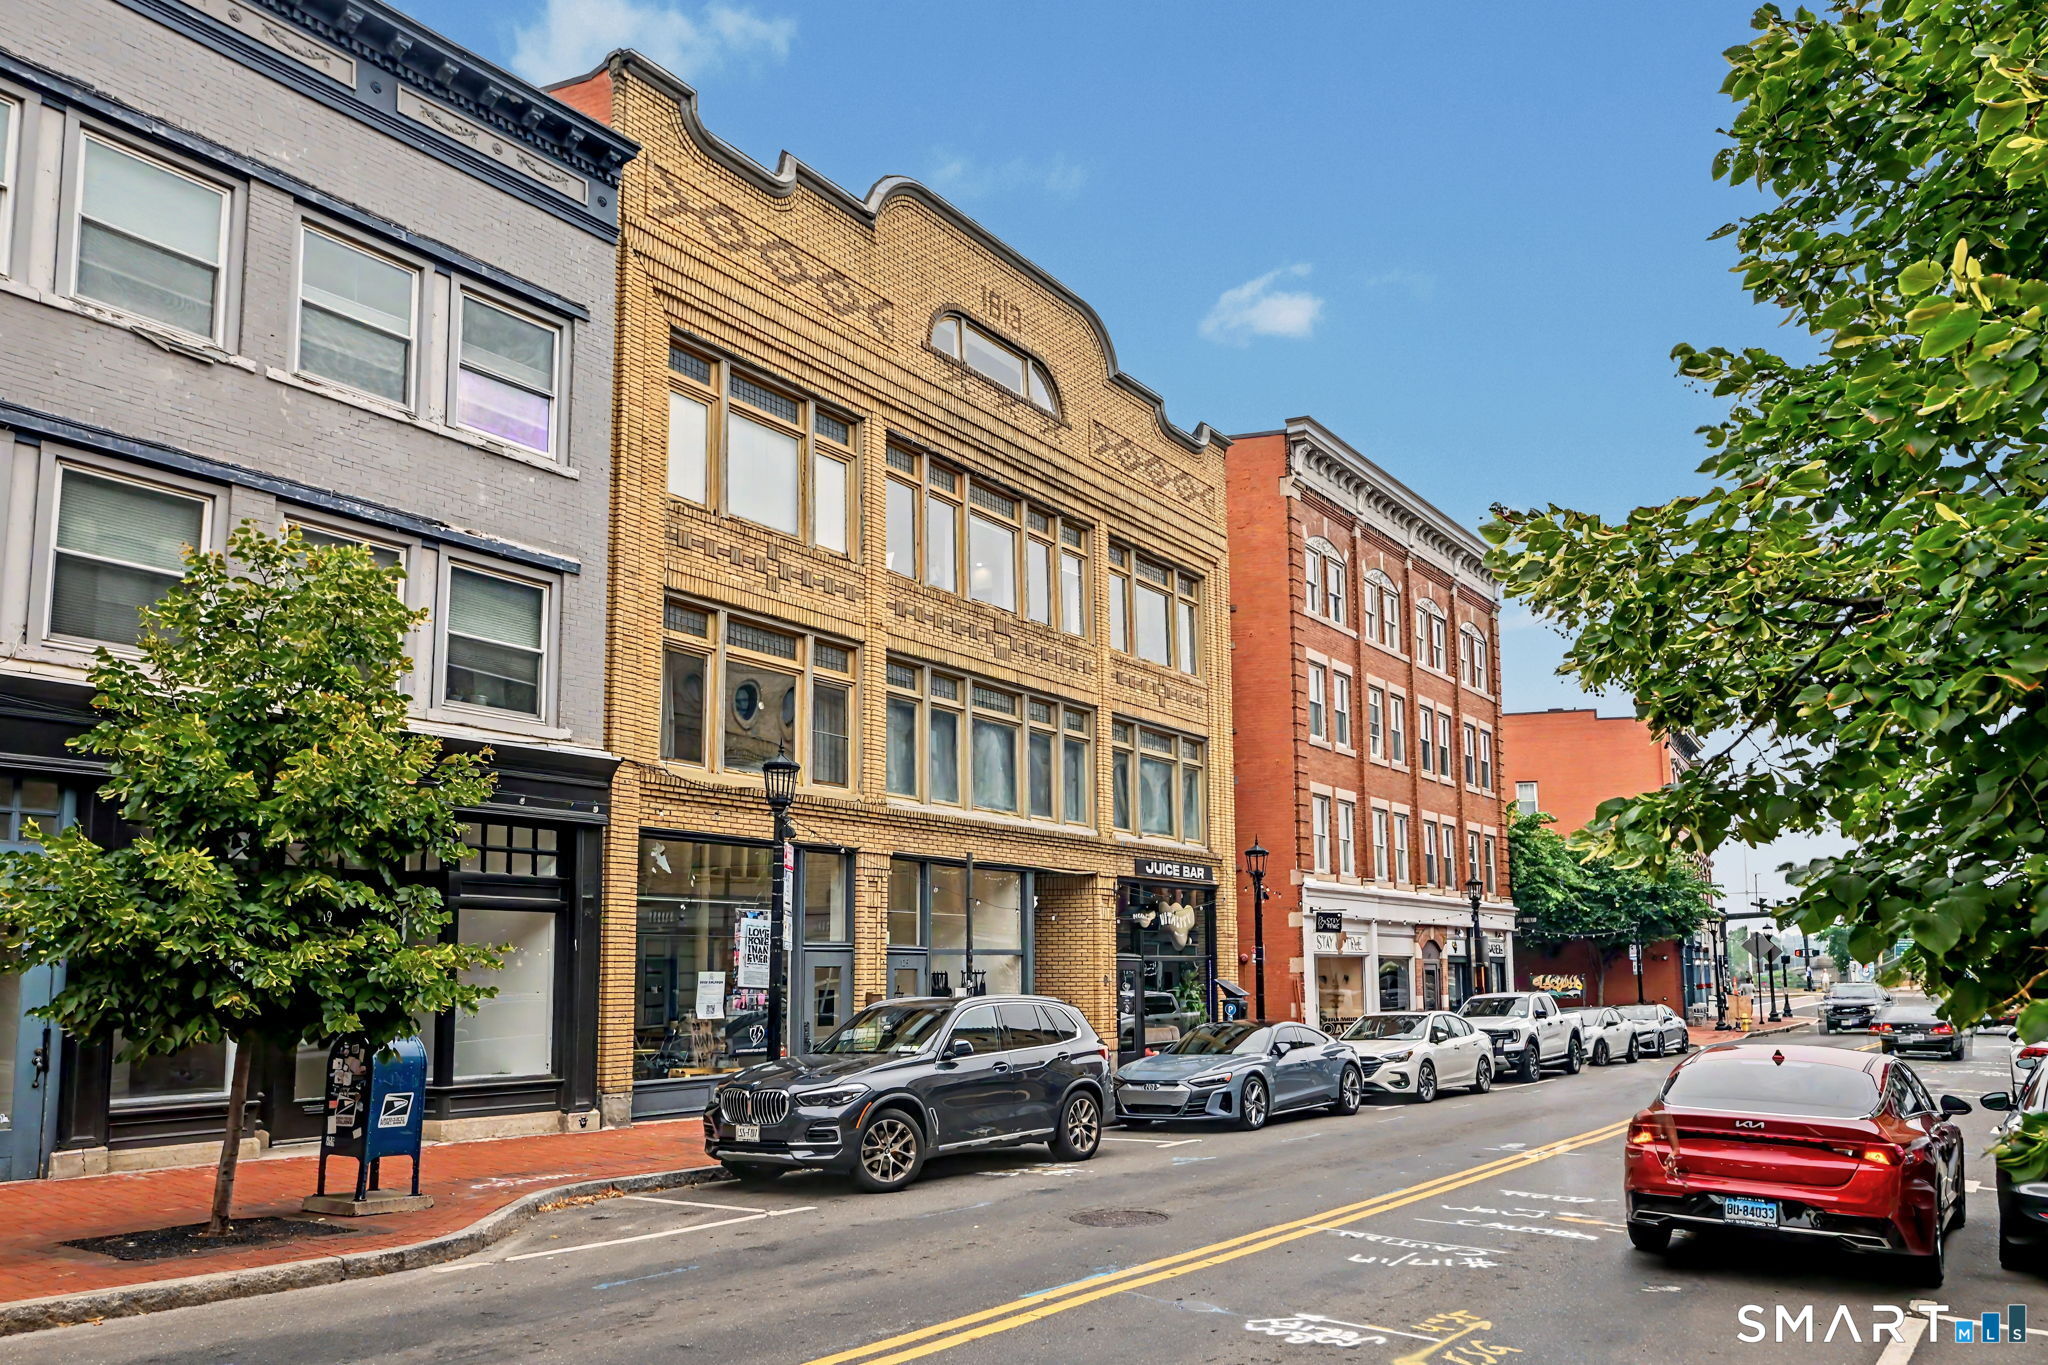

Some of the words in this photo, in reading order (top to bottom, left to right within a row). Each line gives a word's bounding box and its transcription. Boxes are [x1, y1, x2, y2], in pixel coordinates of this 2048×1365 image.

[1145, 861, 1180, 876] JUICE
[1182, 865, 1205, 879] BAR
[748, 927, 769, 938] LOVE
[1316, 934, 1334, 950] STAY
